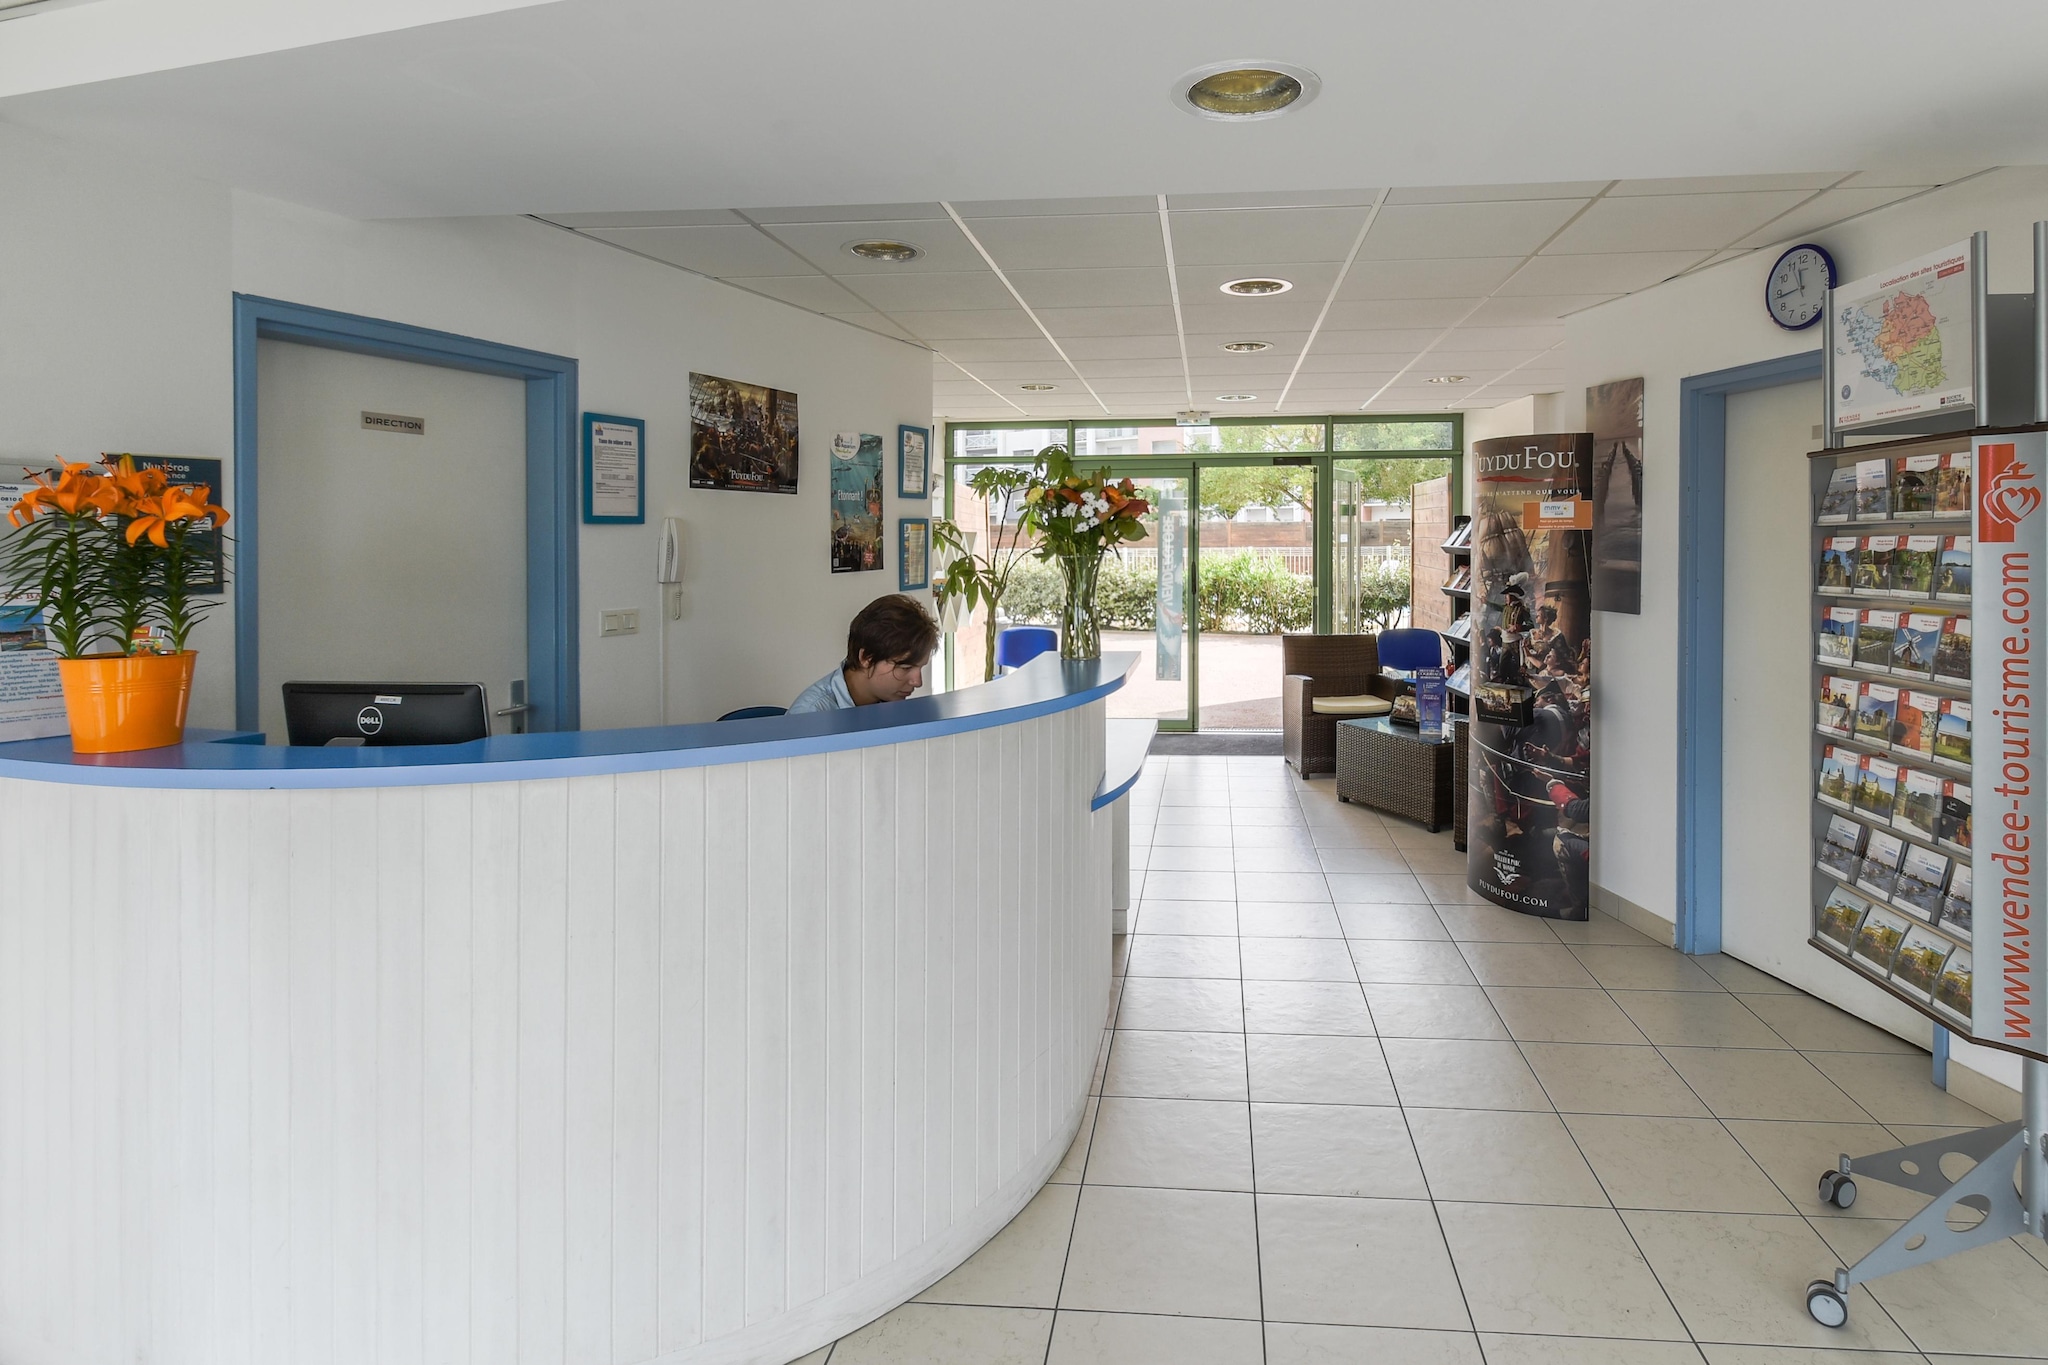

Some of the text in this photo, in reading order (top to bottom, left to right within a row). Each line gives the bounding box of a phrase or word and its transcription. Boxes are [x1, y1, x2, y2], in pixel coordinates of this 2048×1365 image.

[1798, 255, 1808, 264] 12
[1788, 262, 1796, 272] 11
[1821, 264, 1827, 272] 2
[1880, 275, 1909, 289] Localisation
[1910, 270, 1919, 278] des
[1921, 266, 1932, 275] sites
[1933, 255, 1964, 270] touristiques
[1780, 274, 1788, 283] 10
[1777, 290, 1782, 298] 9
[1781, 303, 1786, 311] 8
[1813, 304, 1818, 313] 5
[1789, 310, 1794, 318] 7
[1801, 311, 1806, 320] 6
[365, 416, 422, 430] DIRECTION
[1991, 552, 2032, 1038] www.vendee-tourisme.com
[1480, 879, 1548, 907] PUYDUFOU.COM
